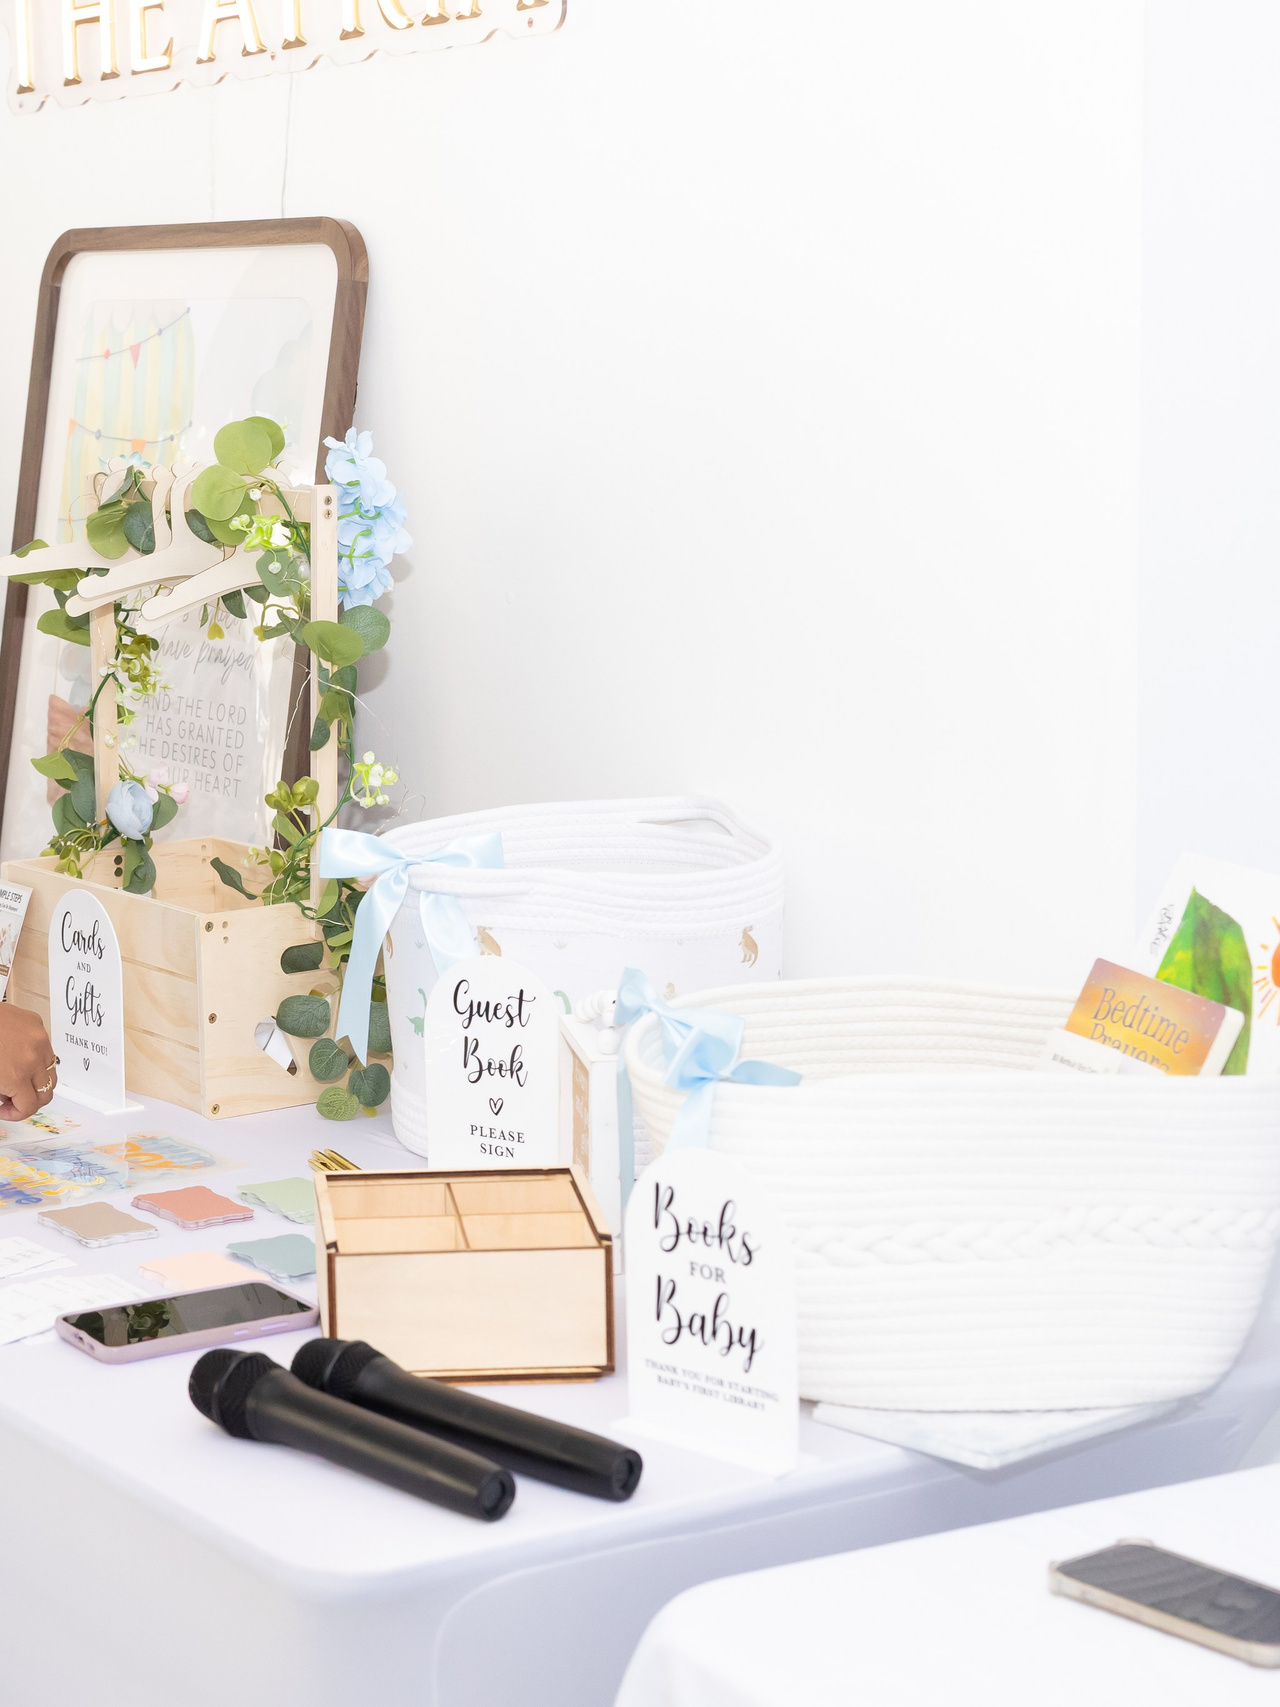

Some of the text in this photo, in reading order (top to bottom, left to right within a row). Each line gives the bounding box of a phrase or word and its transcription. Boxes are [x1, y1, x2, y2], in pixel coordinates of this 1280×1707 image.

[154, 625, 194, 663] have
[142, 692, 247, 725] AND THE LORD
[146, 715, 245, 749] HAS GRANTED
[134, 736, 244, 774] HE DESIRES OF
[195, 771, 241, 798] HEART
[61, 911, 105, 960] Cards
[77, 962, 91, 973] AND
[66, 976, 105, 1027] Gifts
[453, 979, 536, 1030] Guest
[1093, 987, 1189, 1054] Bedtime
[65, 1033, 108, 1056] THANK YOU!
[463, 1036, 528, 1087] Book
[470, 1124, 525, 1144] PLEASE
[480, 1142, 515, 1158] SIGN
[654, 1182, 761, 1266] Books
[689, 1261, 726, 1284] FOR
[656, 1275, 765, 1373] Baby
[645, 1359, 778, 1402] THANK YOU FOR STARTING
[692, 1384, 719, 1399] FIRST
[723, 1393, 765, 1411] LIBRARY
